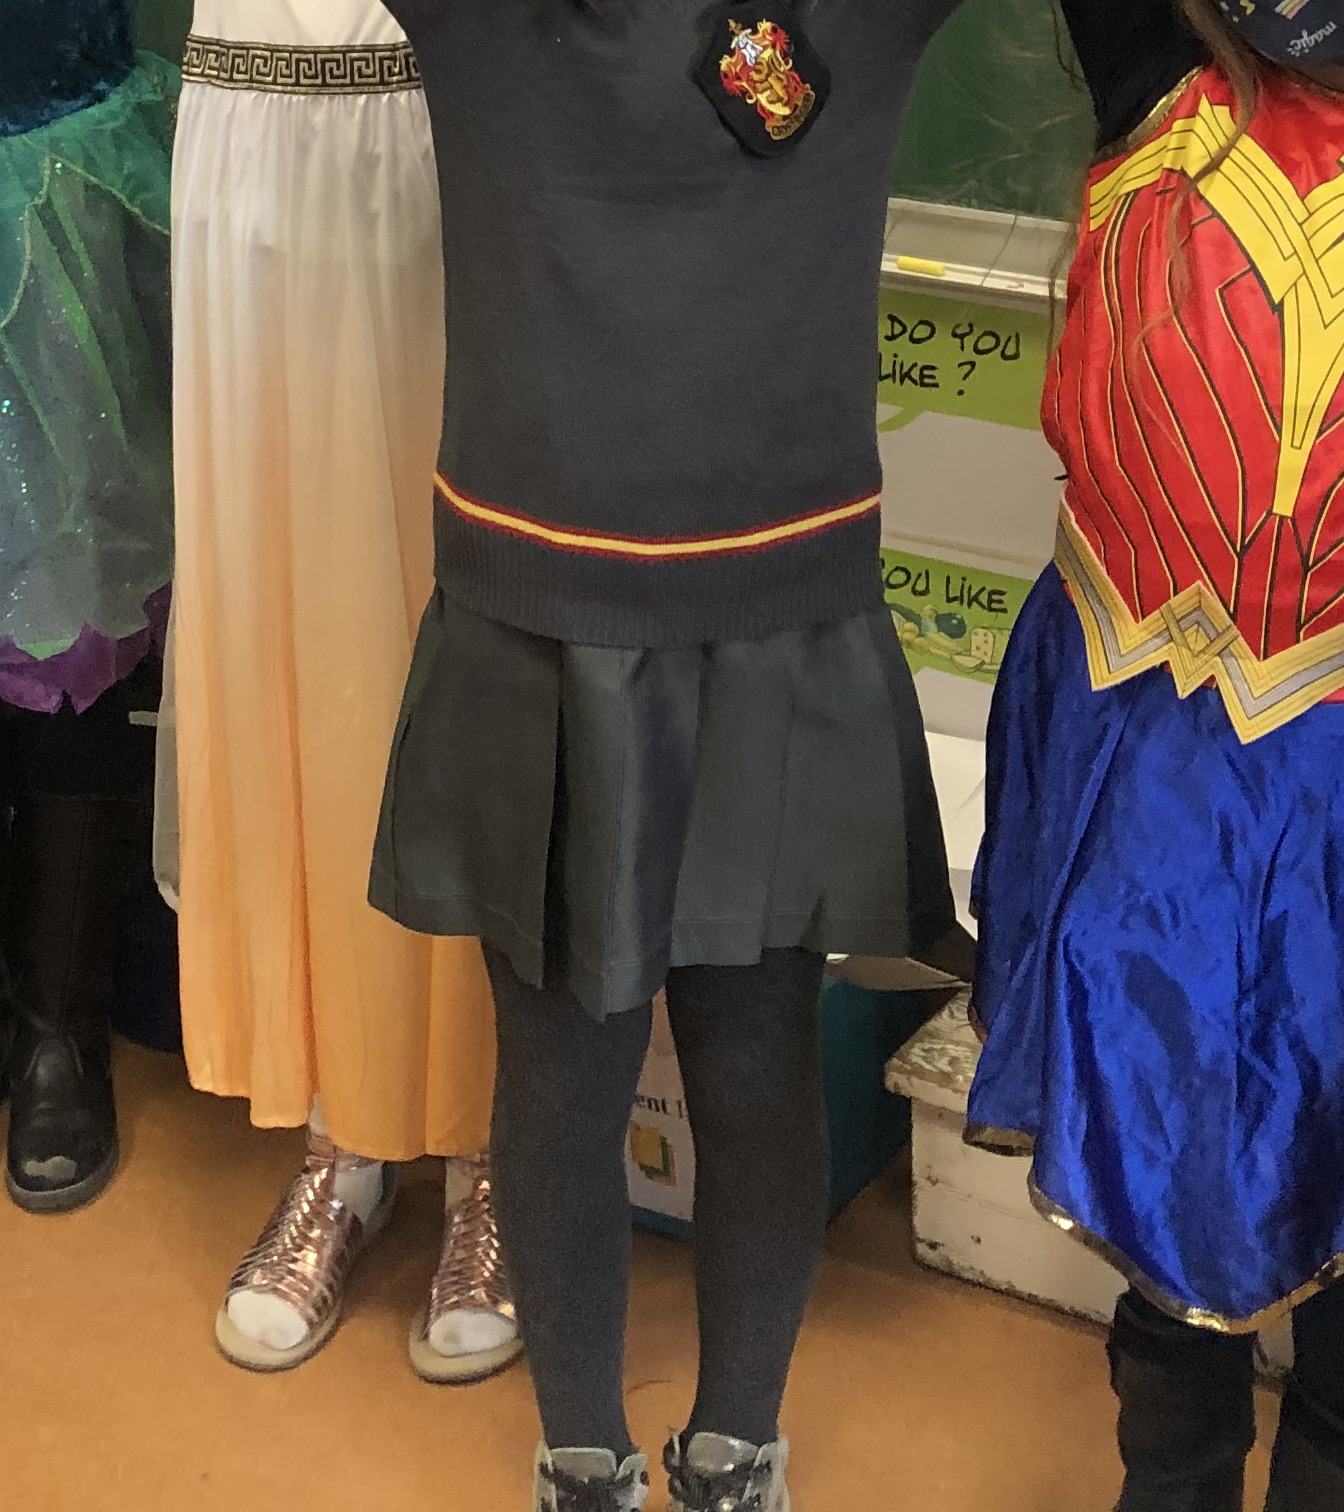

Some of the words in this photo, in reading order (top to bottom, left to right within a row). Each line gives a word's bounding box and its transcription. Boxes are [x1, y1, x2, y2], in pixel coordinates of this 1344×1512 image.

[884, 313, 936, 345] DO
[950, 321, 1021, 362] YOU
[957, 361, 976, 396] ?
[881, 561, 932, 597] OU
